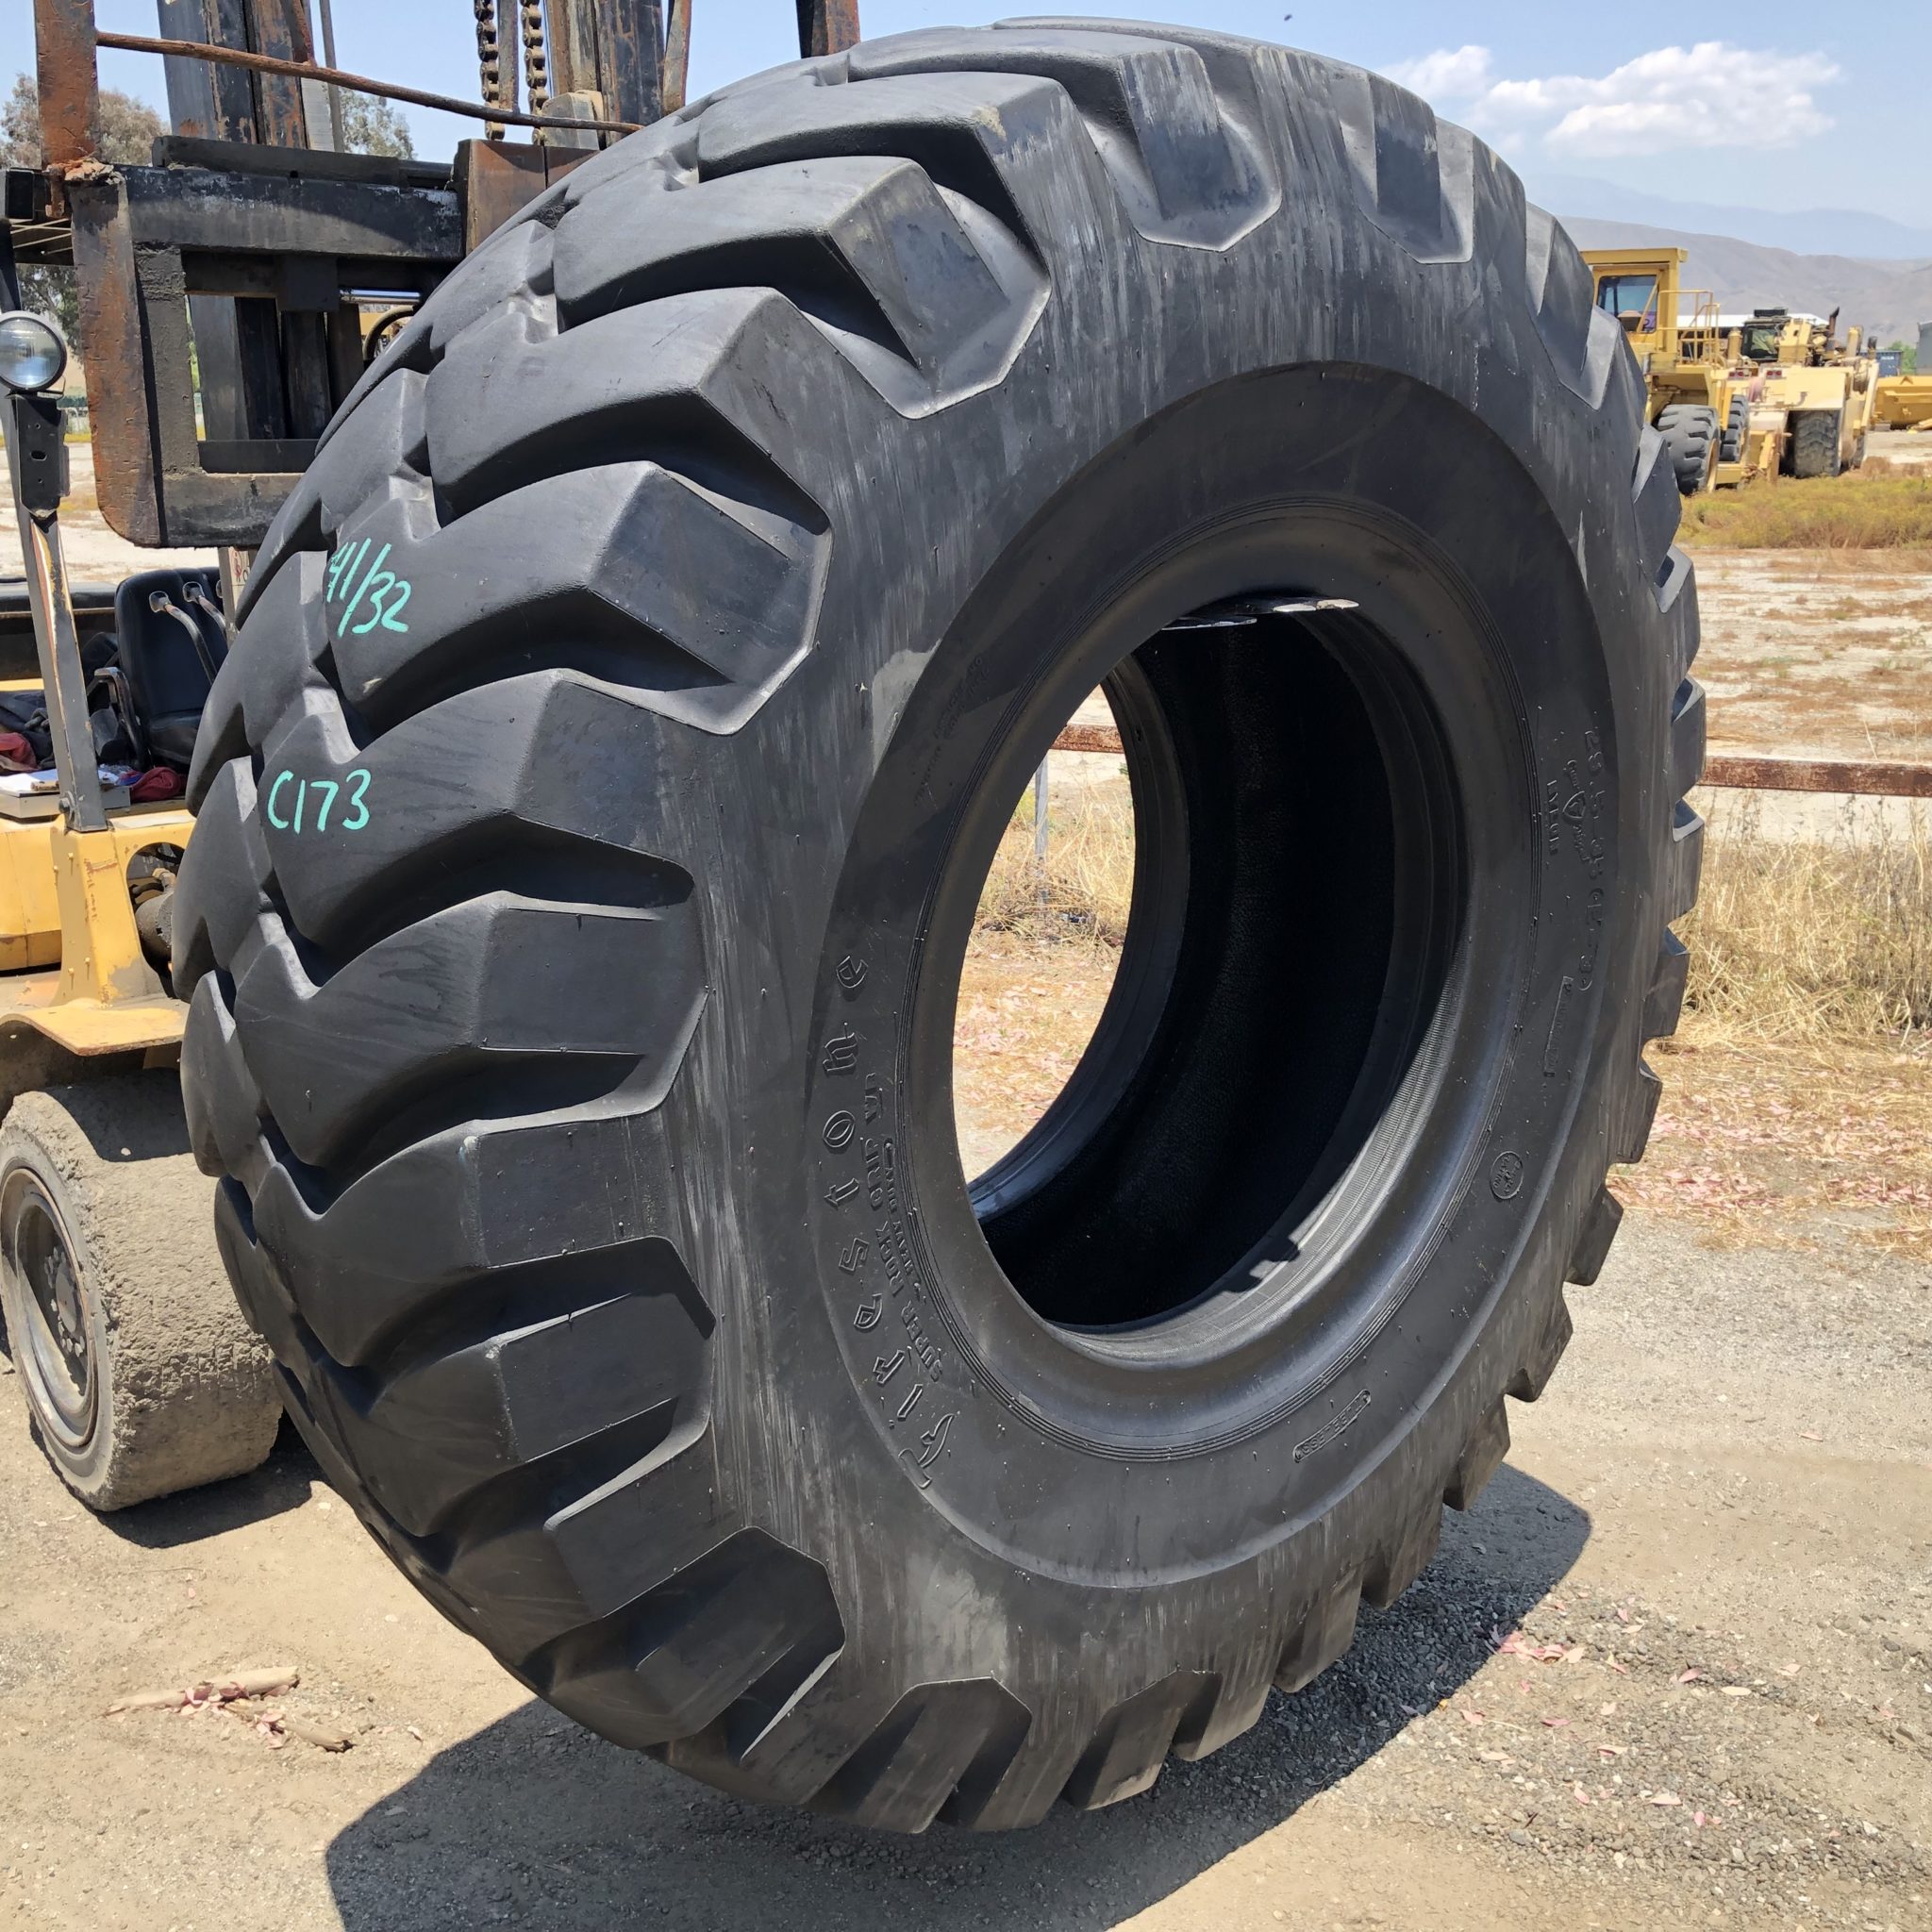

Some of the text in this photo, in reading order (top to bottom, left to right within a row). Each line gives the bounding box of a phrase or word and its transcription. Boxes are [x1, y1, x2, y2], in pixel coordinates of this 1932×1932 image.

[327, 538, 411, 637] 41/32
[268, 769, 372, 834] C173
[864, 1138, 884, 1210] GRIP
[822, 956, 955, 1489] Firestone
[875, 1221, 905, 1297] ROCK
[886, 1167, 916, 1274] HEAVY DUTY
[901, 1299, 943, 1382] SUPER
